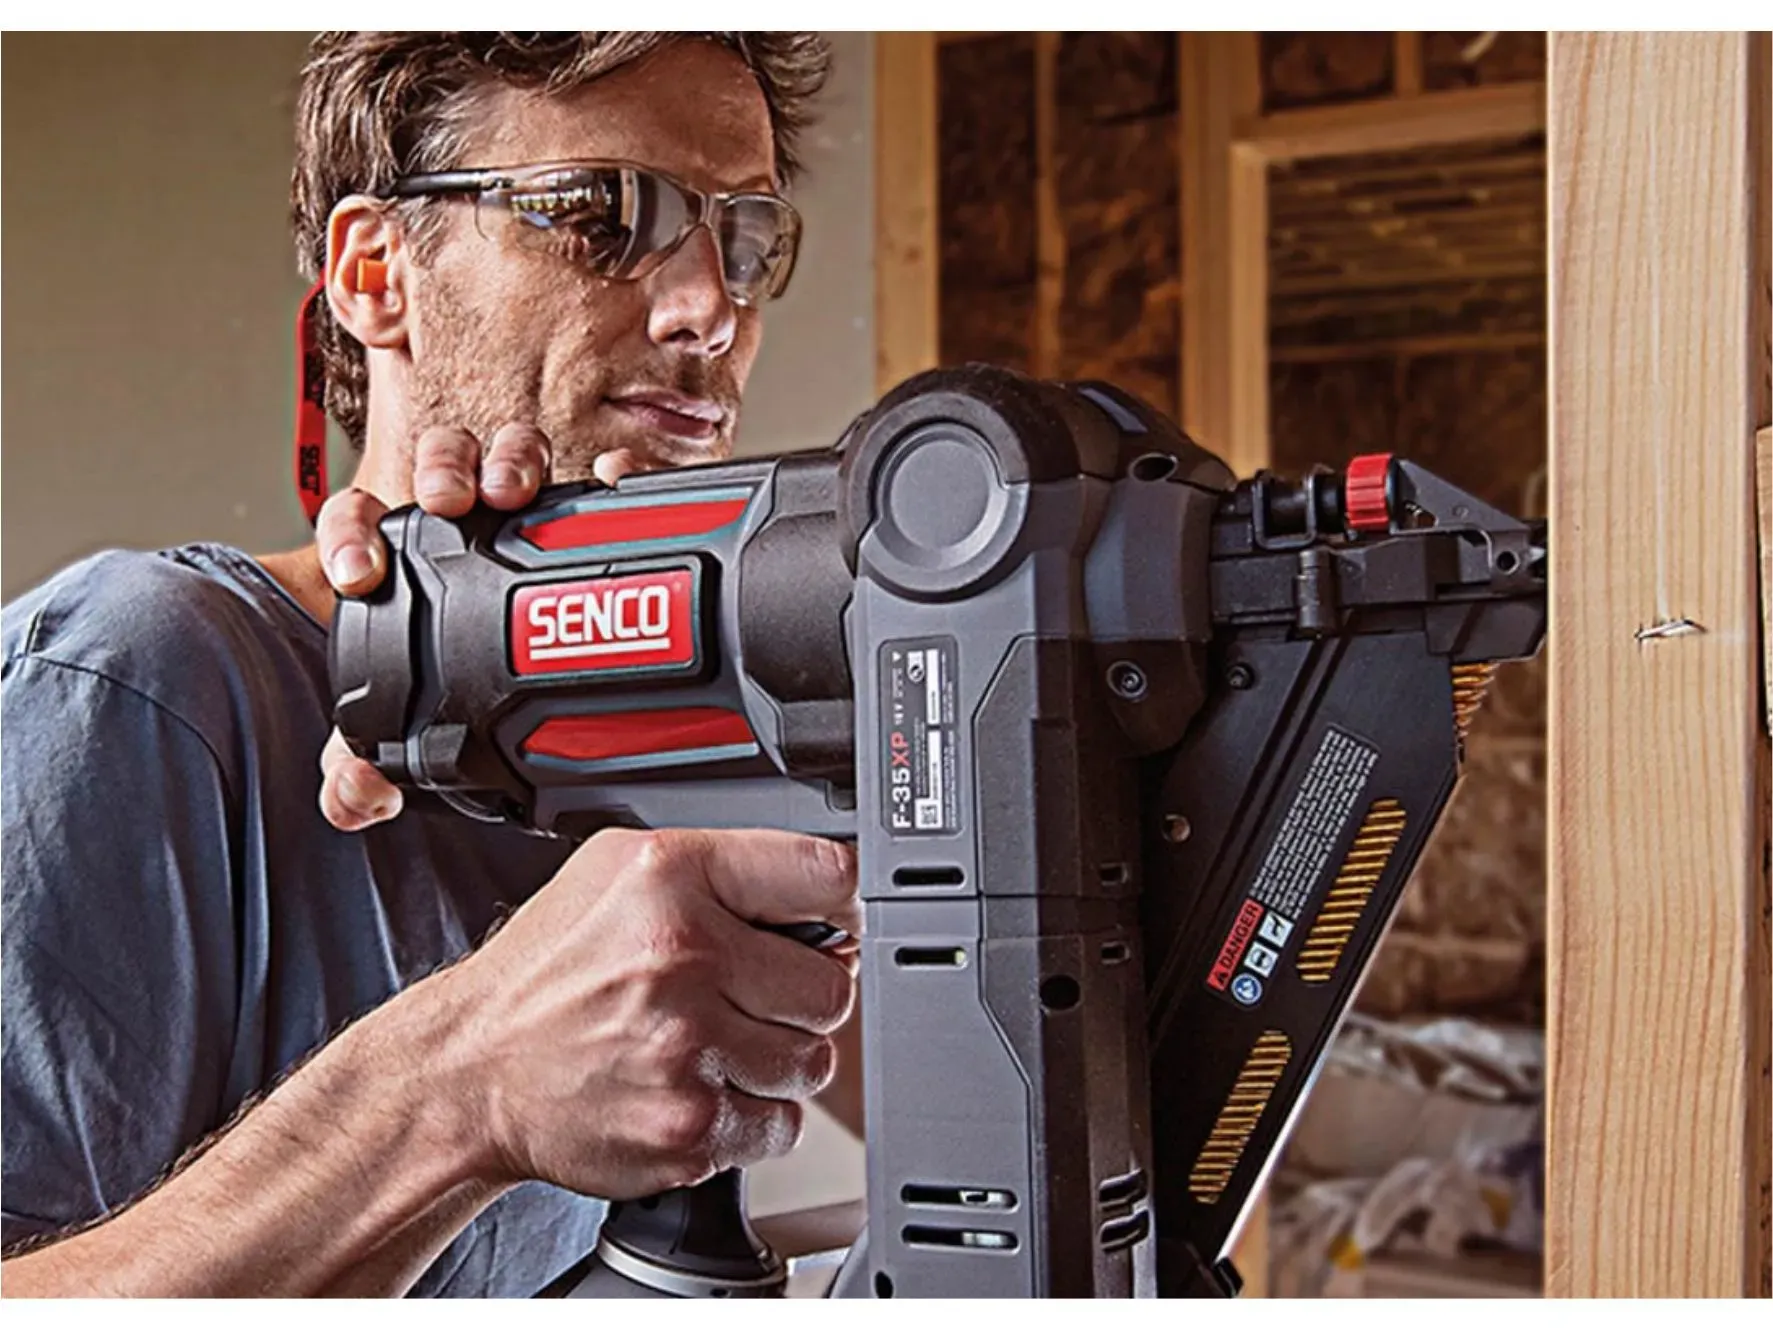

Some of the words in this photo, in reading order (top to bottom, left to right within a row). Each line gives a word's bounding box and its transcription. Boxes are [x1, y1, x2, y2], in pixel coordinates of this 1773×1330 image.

[528, 585, 669, 647] SENCO
[891, 731, 912, 829] F-35XP
[1219, 904, 1260, 969] DANGER
